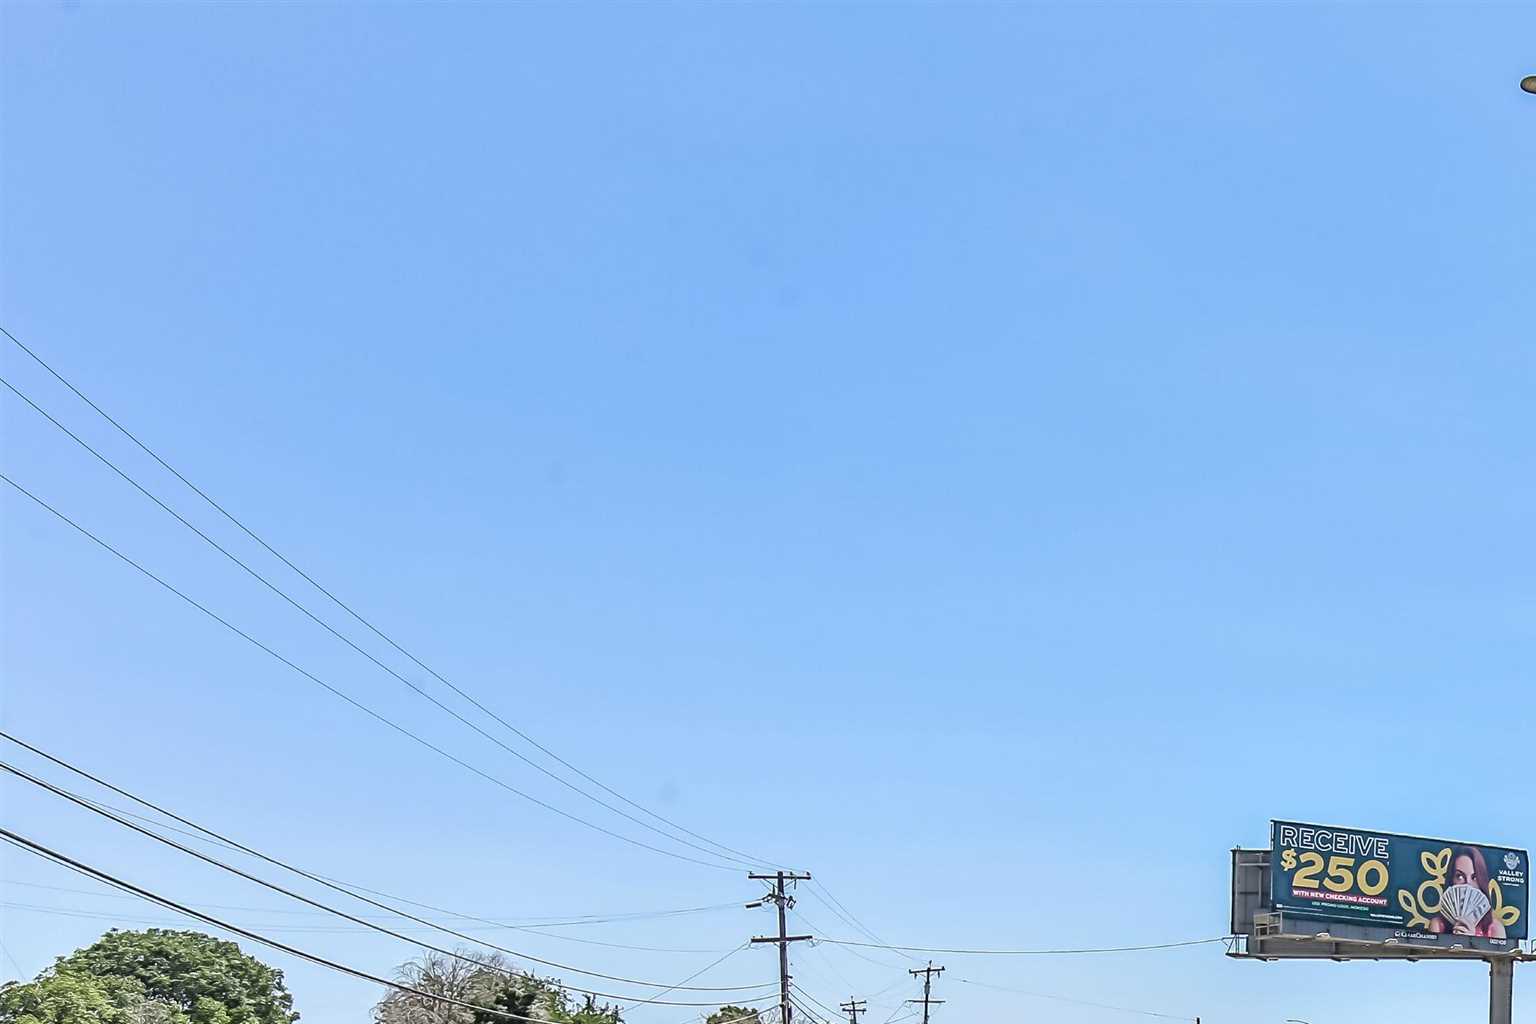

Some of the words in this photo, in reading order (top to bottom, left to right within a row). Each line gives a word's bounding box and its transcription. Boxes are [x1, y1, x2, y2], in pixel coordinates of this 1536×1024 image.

[1280, 825, 1389, 858] RECEIVE
[1280, 848, 1389, 896] $250
[1325, 893, 1357, 902] CHECKING
[1358, 897, 1387, 905] ACCOUNT
